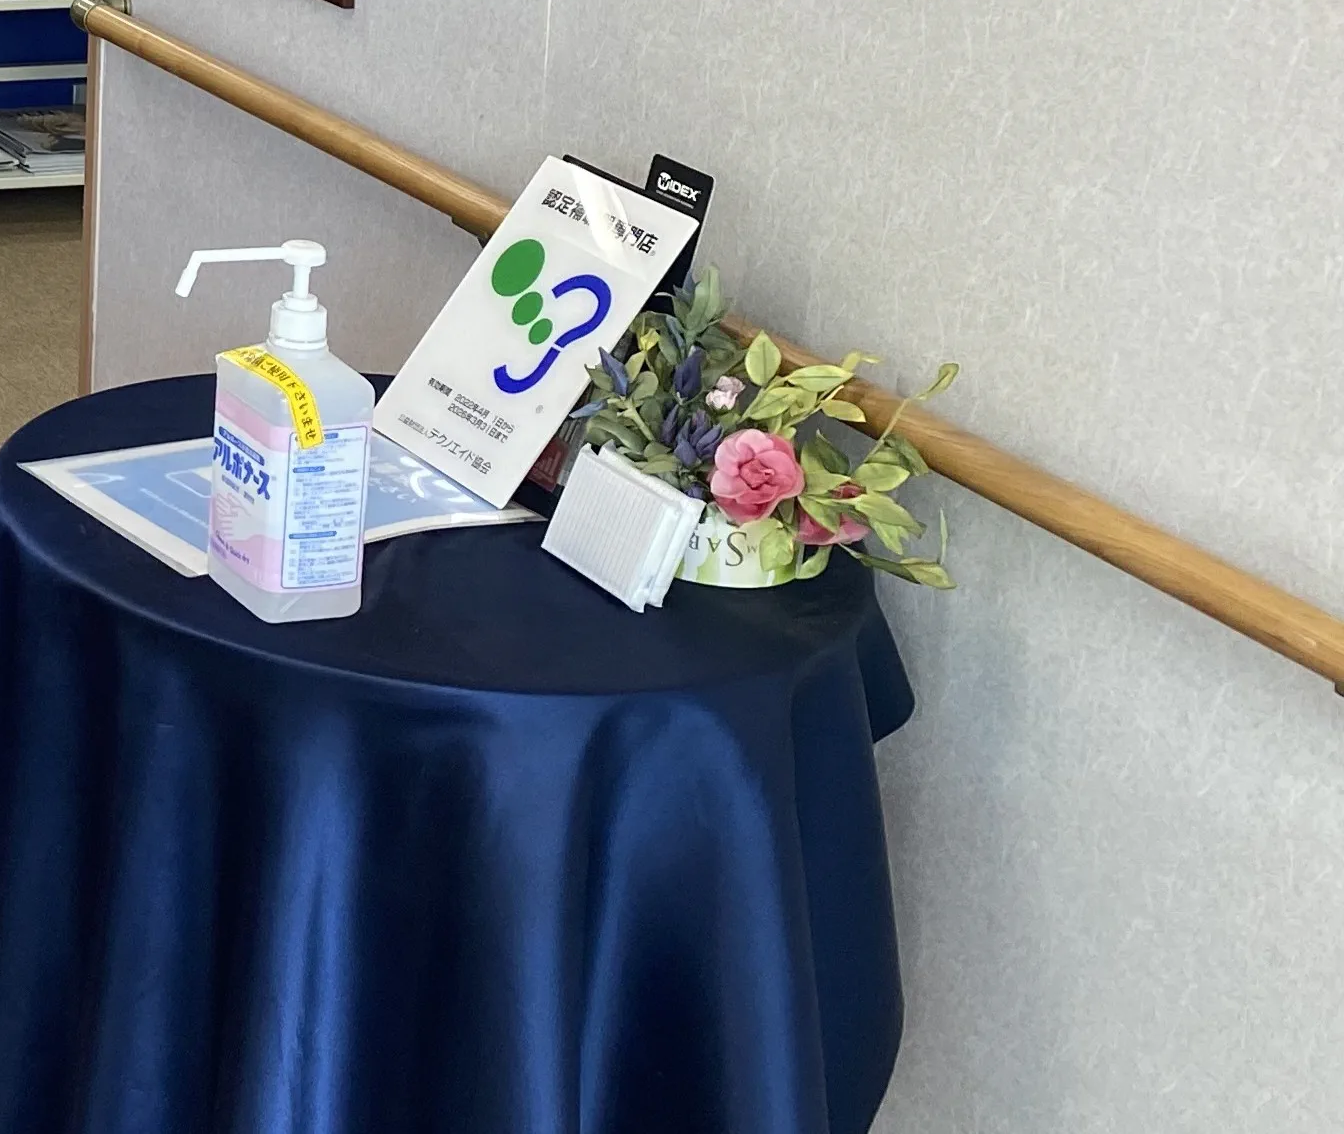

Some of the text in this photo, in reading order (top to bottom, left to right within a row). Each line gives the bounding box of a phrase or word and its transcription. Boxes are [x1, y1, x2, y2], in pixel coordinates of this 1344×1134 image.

[657, 171, 699, 202] WIDEX
[541, 188, 659, 254] 認定補専門店
[213, 436, 271, 501] アルボナース
